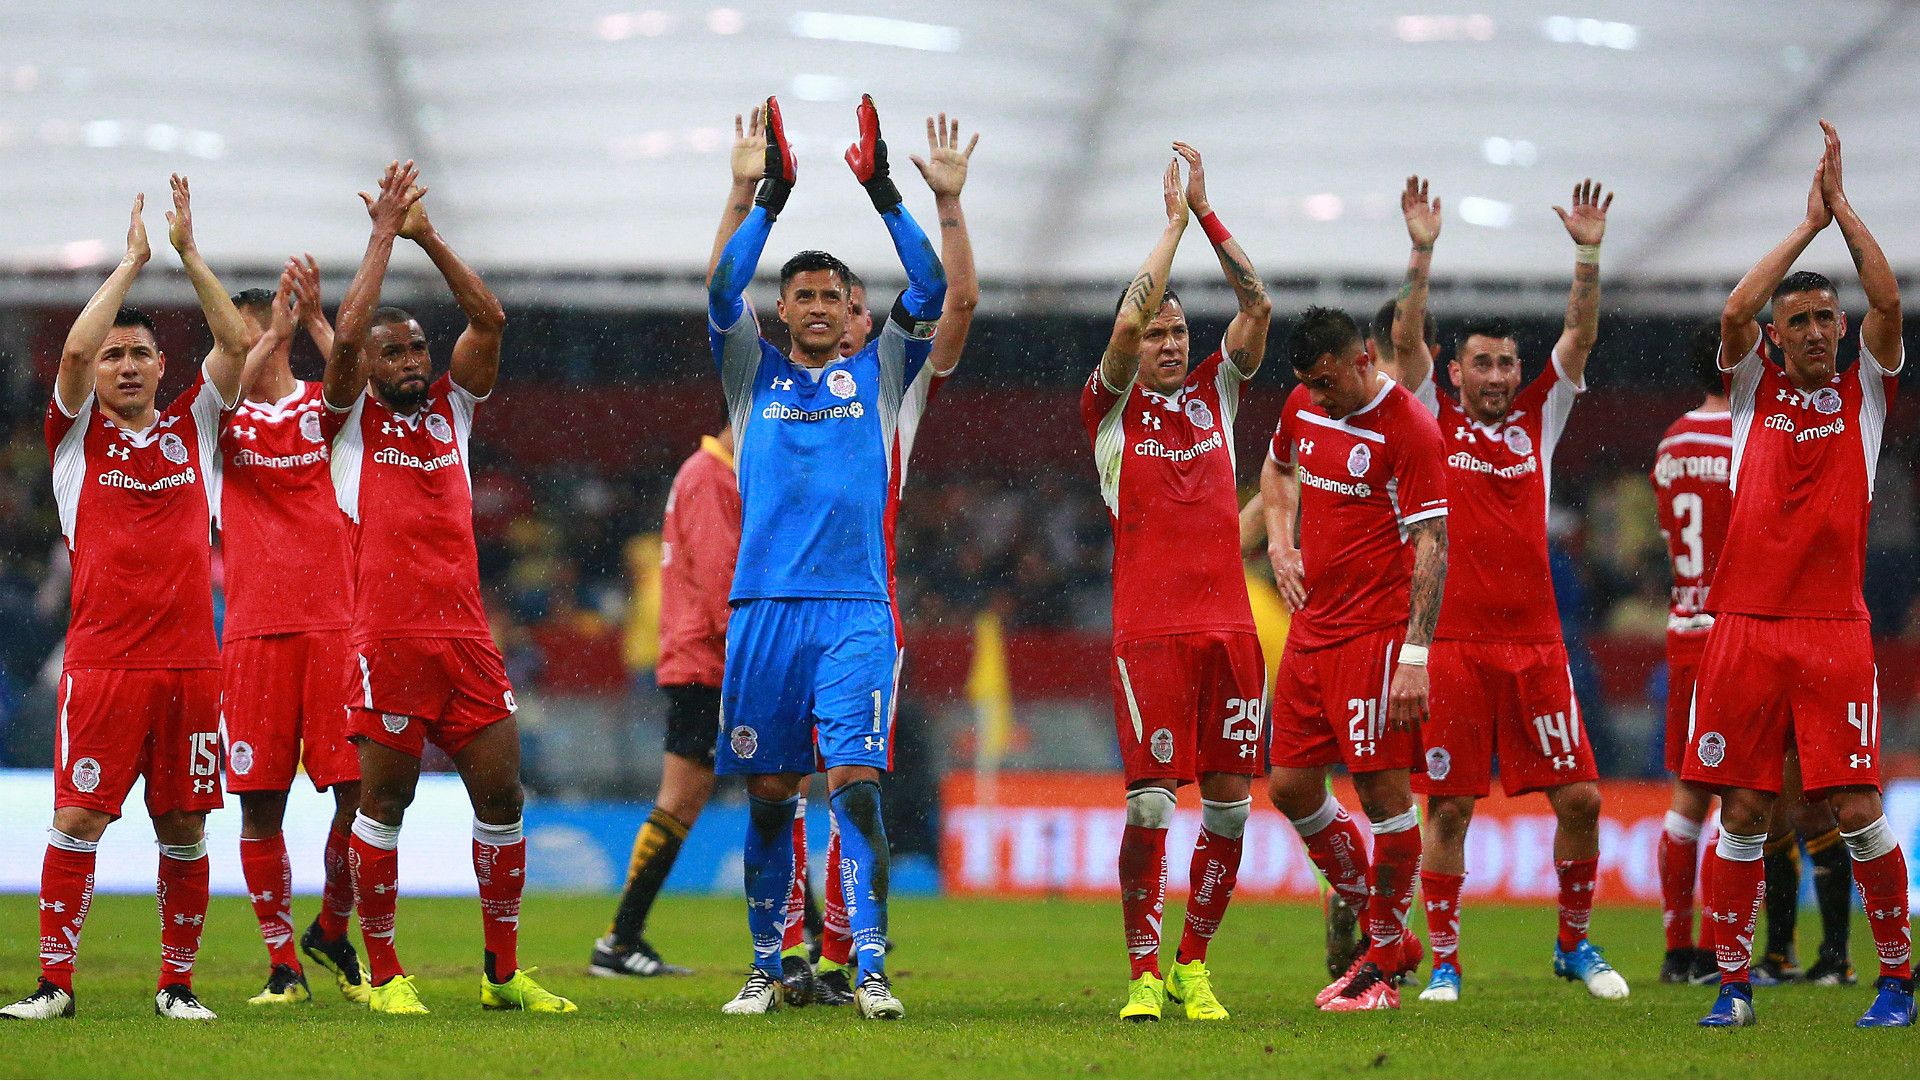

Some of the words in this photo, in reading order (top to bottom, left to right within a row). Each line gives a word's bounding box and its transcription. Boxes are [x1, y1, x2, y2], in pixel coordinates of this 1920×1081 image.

[762, 402, 850, 423] citibanamex
[1763, 414, 1834, 443] citibamex
[233, 448, 319, 468] citibanamex
[373, 447, 453, 471] citibaamex
[1447, 450, 1529, 478] citibamex
[1655, 453, 1728, 487] Corona
[1672, 493, 1703, 578] 3
[871, 689, 881, 733] 1
[1223, 698, 1260, 741] 29
[1348, 698, 1377, 741] 21
[1847, 702, 1868, 748] 4
[189, 732, 217, 776] 15
[1532, 711, 1572, 757] 14
[77, 873, 94, 918] AEROMEXICO
[841, 858, 857, 905] AEROMEXICO
